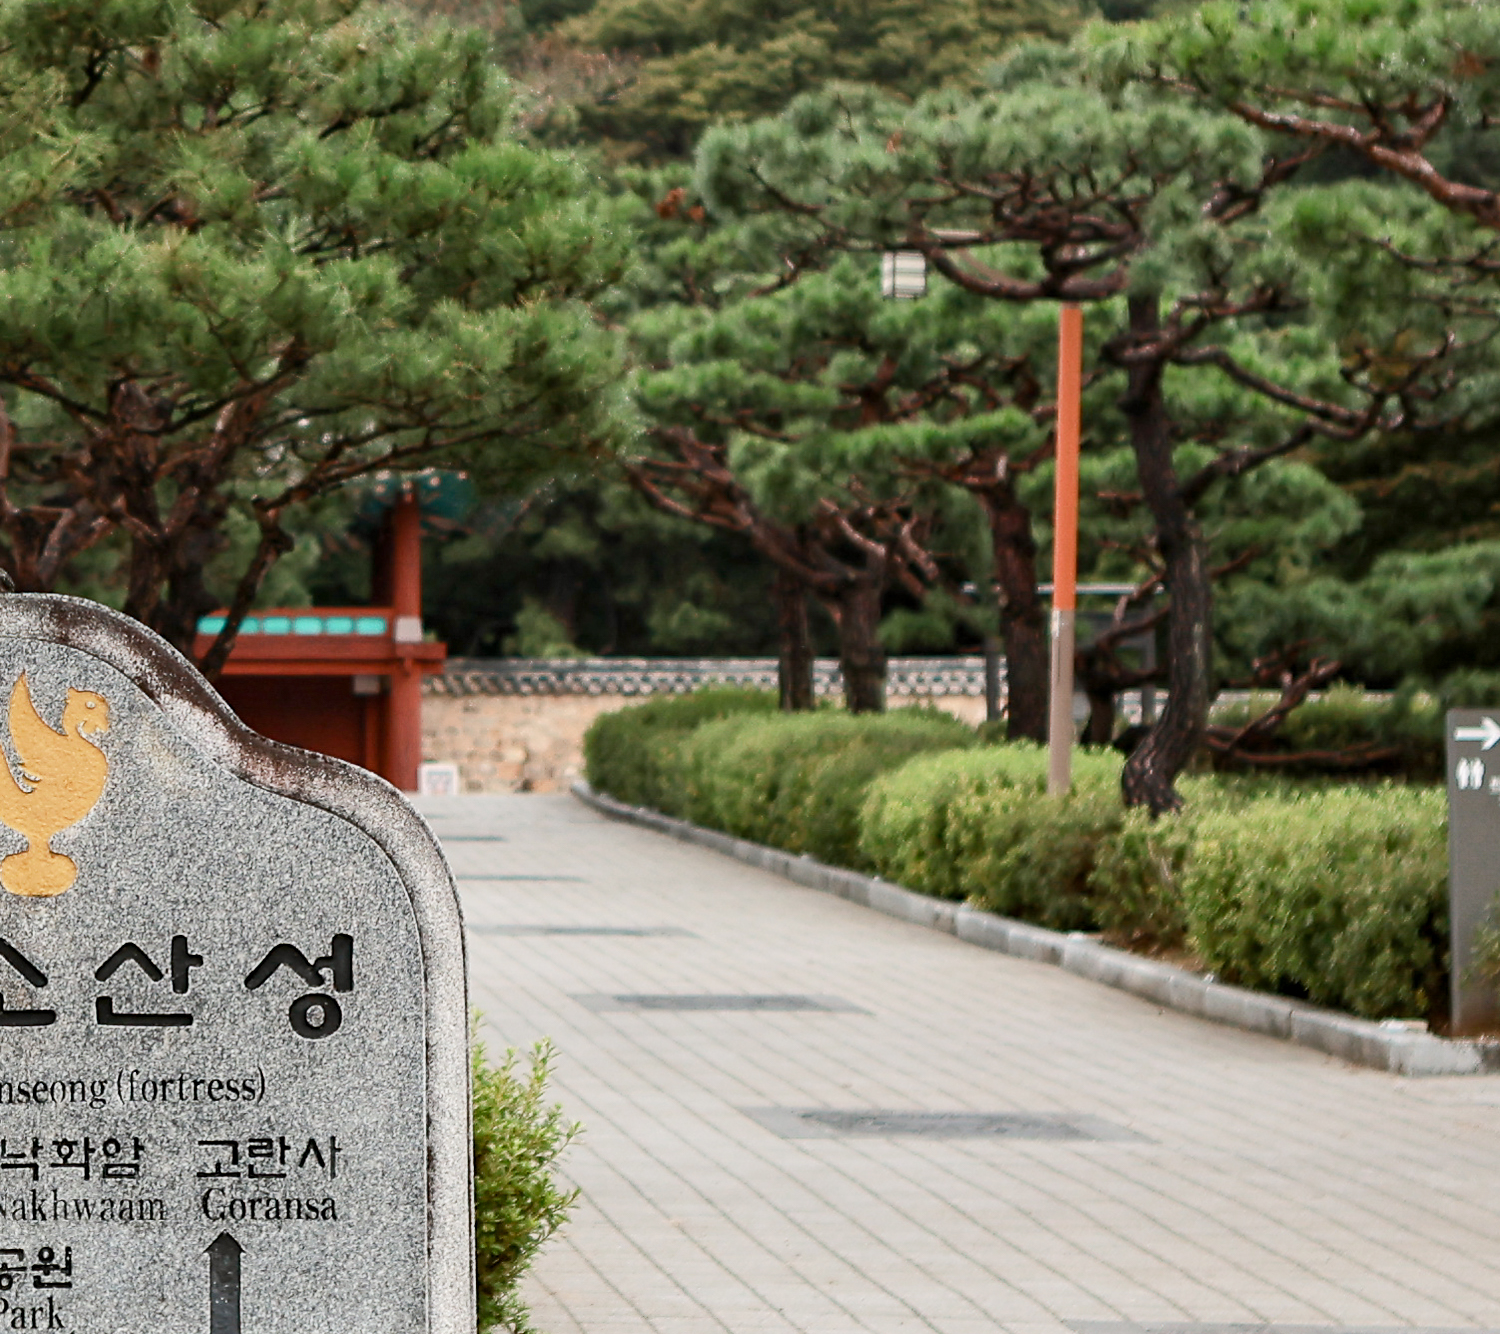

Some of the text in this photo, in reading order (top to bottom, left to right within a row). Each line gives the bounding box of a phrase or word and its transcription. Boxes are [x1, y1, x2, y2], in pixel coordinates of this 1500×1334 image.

[116, 1067, 266, 1105] (fortress)
[0, 1136, 144, 1181] 낙화암
[196, 1135, 341, 1180] 고란사
[202, 1186, 338, 1222] Goransa
